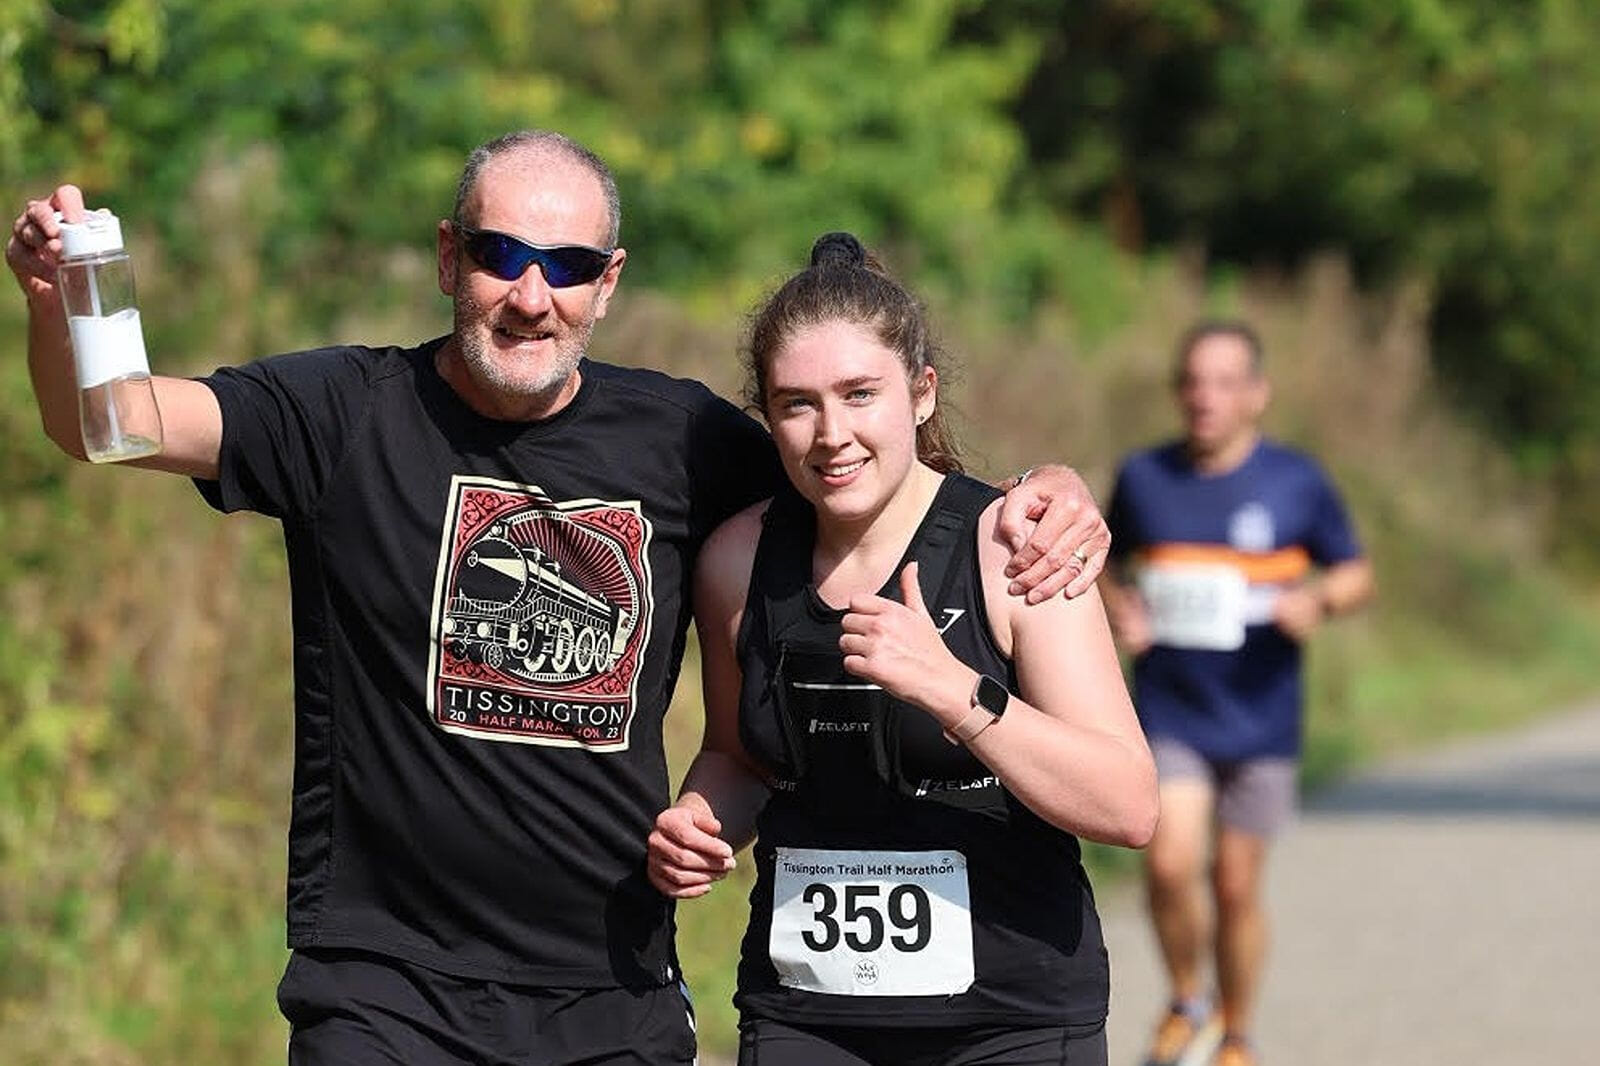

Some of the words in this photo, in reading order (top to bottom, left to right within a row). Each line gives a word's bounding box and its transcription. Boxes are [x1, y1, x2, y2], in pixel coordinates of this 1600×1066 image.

[446, 686, 624, 725] TISSINGTON
[449, 709, 467, 722] 20
[479, 714, 516, 727] HALF
[607, 727, 618, 739] 23
[933, 776, 1000, 791] ZELAFI
[785, 863, 834, 875] Tissington
[839, 864, 864, 875] Trail
[867, 864, 892, 875] Half
[895, 864, 954, 876] Marathon
[801, 884, 931, 952] 359
